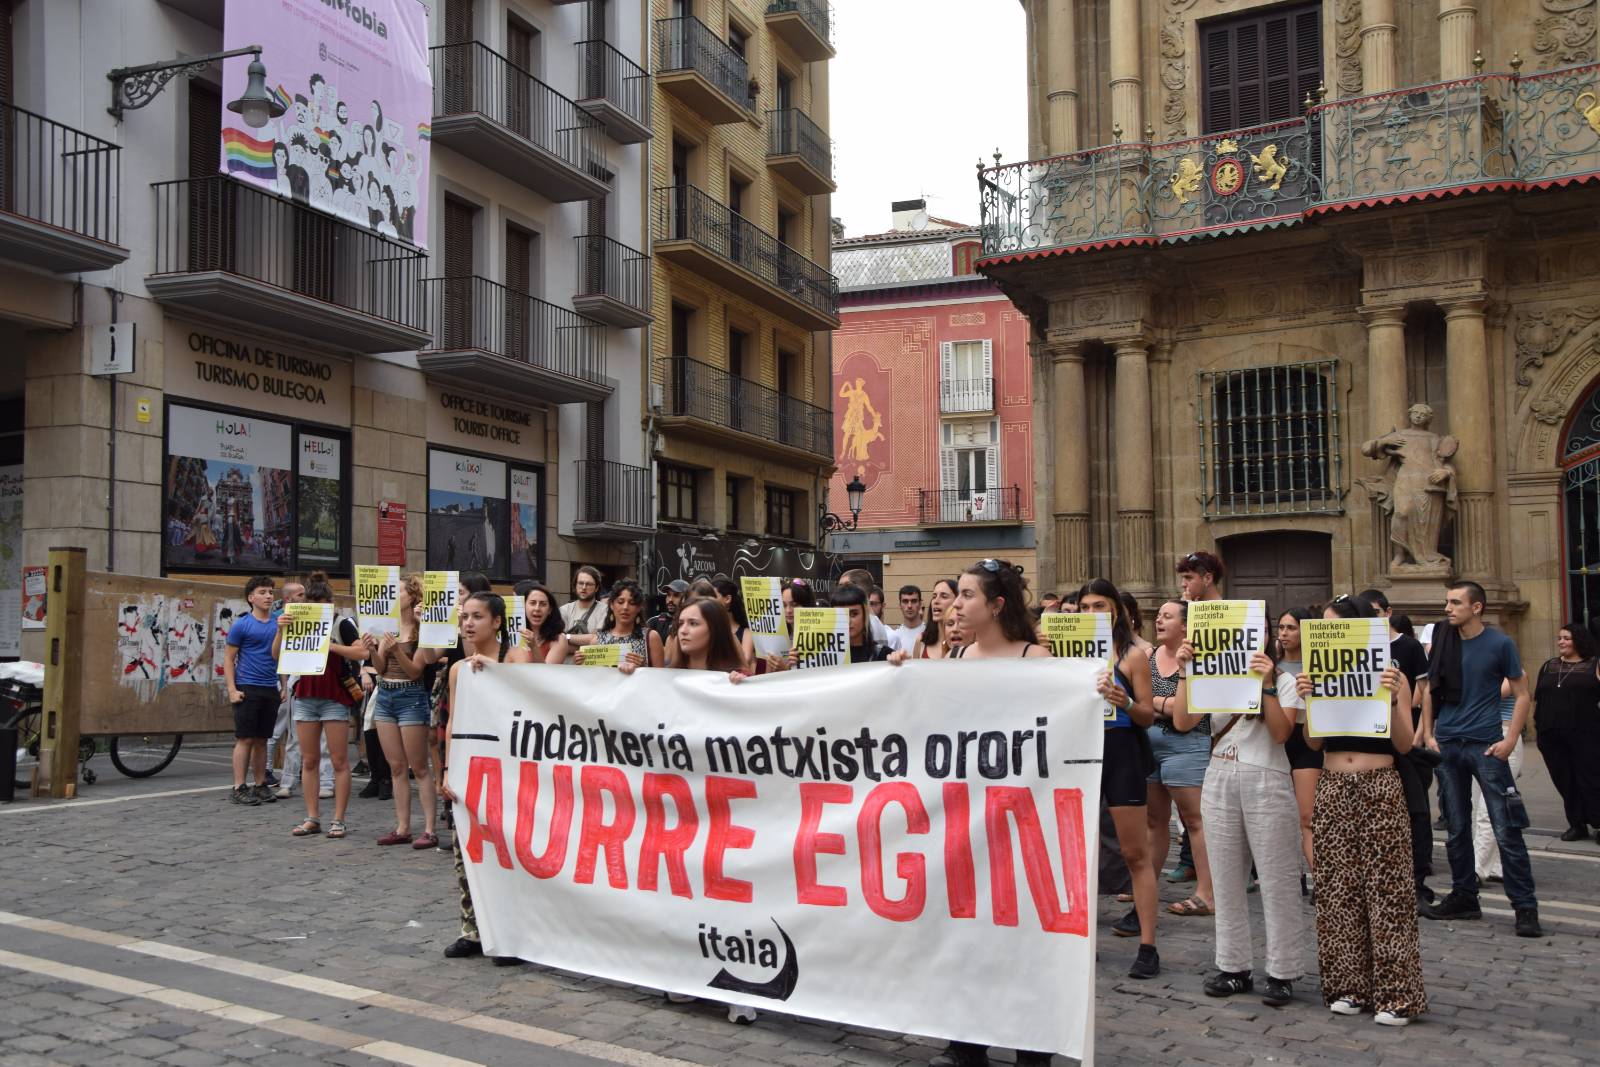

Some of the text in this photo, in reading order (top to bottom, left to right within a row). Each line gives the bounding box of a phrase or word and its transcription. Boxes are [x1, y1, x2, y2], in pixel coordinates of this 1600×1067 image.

[188, 332, 332, 381] OFICINA DE TURISMO
[195, 361, 326, 405] TURISMO BULEGOA
[441, 393, 531, 426] OFFICE DE TOURISME
[454, 417, 520, 445] TOURIST OFFICE
[694, 560, 716, 571] AZCONA
[359, 583, 396, 600] AURRE
[359, 600, 389, 616] EGIN!
[747, 598, 781, 616] AURRE
[1194, 604, 1229, 612] Indarkeria
[1194, 612, 1224, 620] matxista
[287, 620, 329, 637] AURRE
[750, 615, 777, 634] EGIN!
[1048, 616, 1080, 624] Indarkeria
[1048, 624, 1076, 632] matxista
[1309, 622, 1350, 631] Indarkeria
[285, 636, 320, 652] EGIN!
[796, 632, 846, 653] AURRE
[1192, 628, 1258, 651] AURRE
[1309, 632, 1346, 640] matxista
[1192, 652, 1248, 675] EGIN!
[1308, 648, 1384, 673] AURRE
[1311, 673, 1373, 697] EGIN!
[510, 711, 1049, 782] indarkeria matxista orori
[465, 756, 1089, 937] AURRE EGIN
[698, 923, 778, 969] itaia
